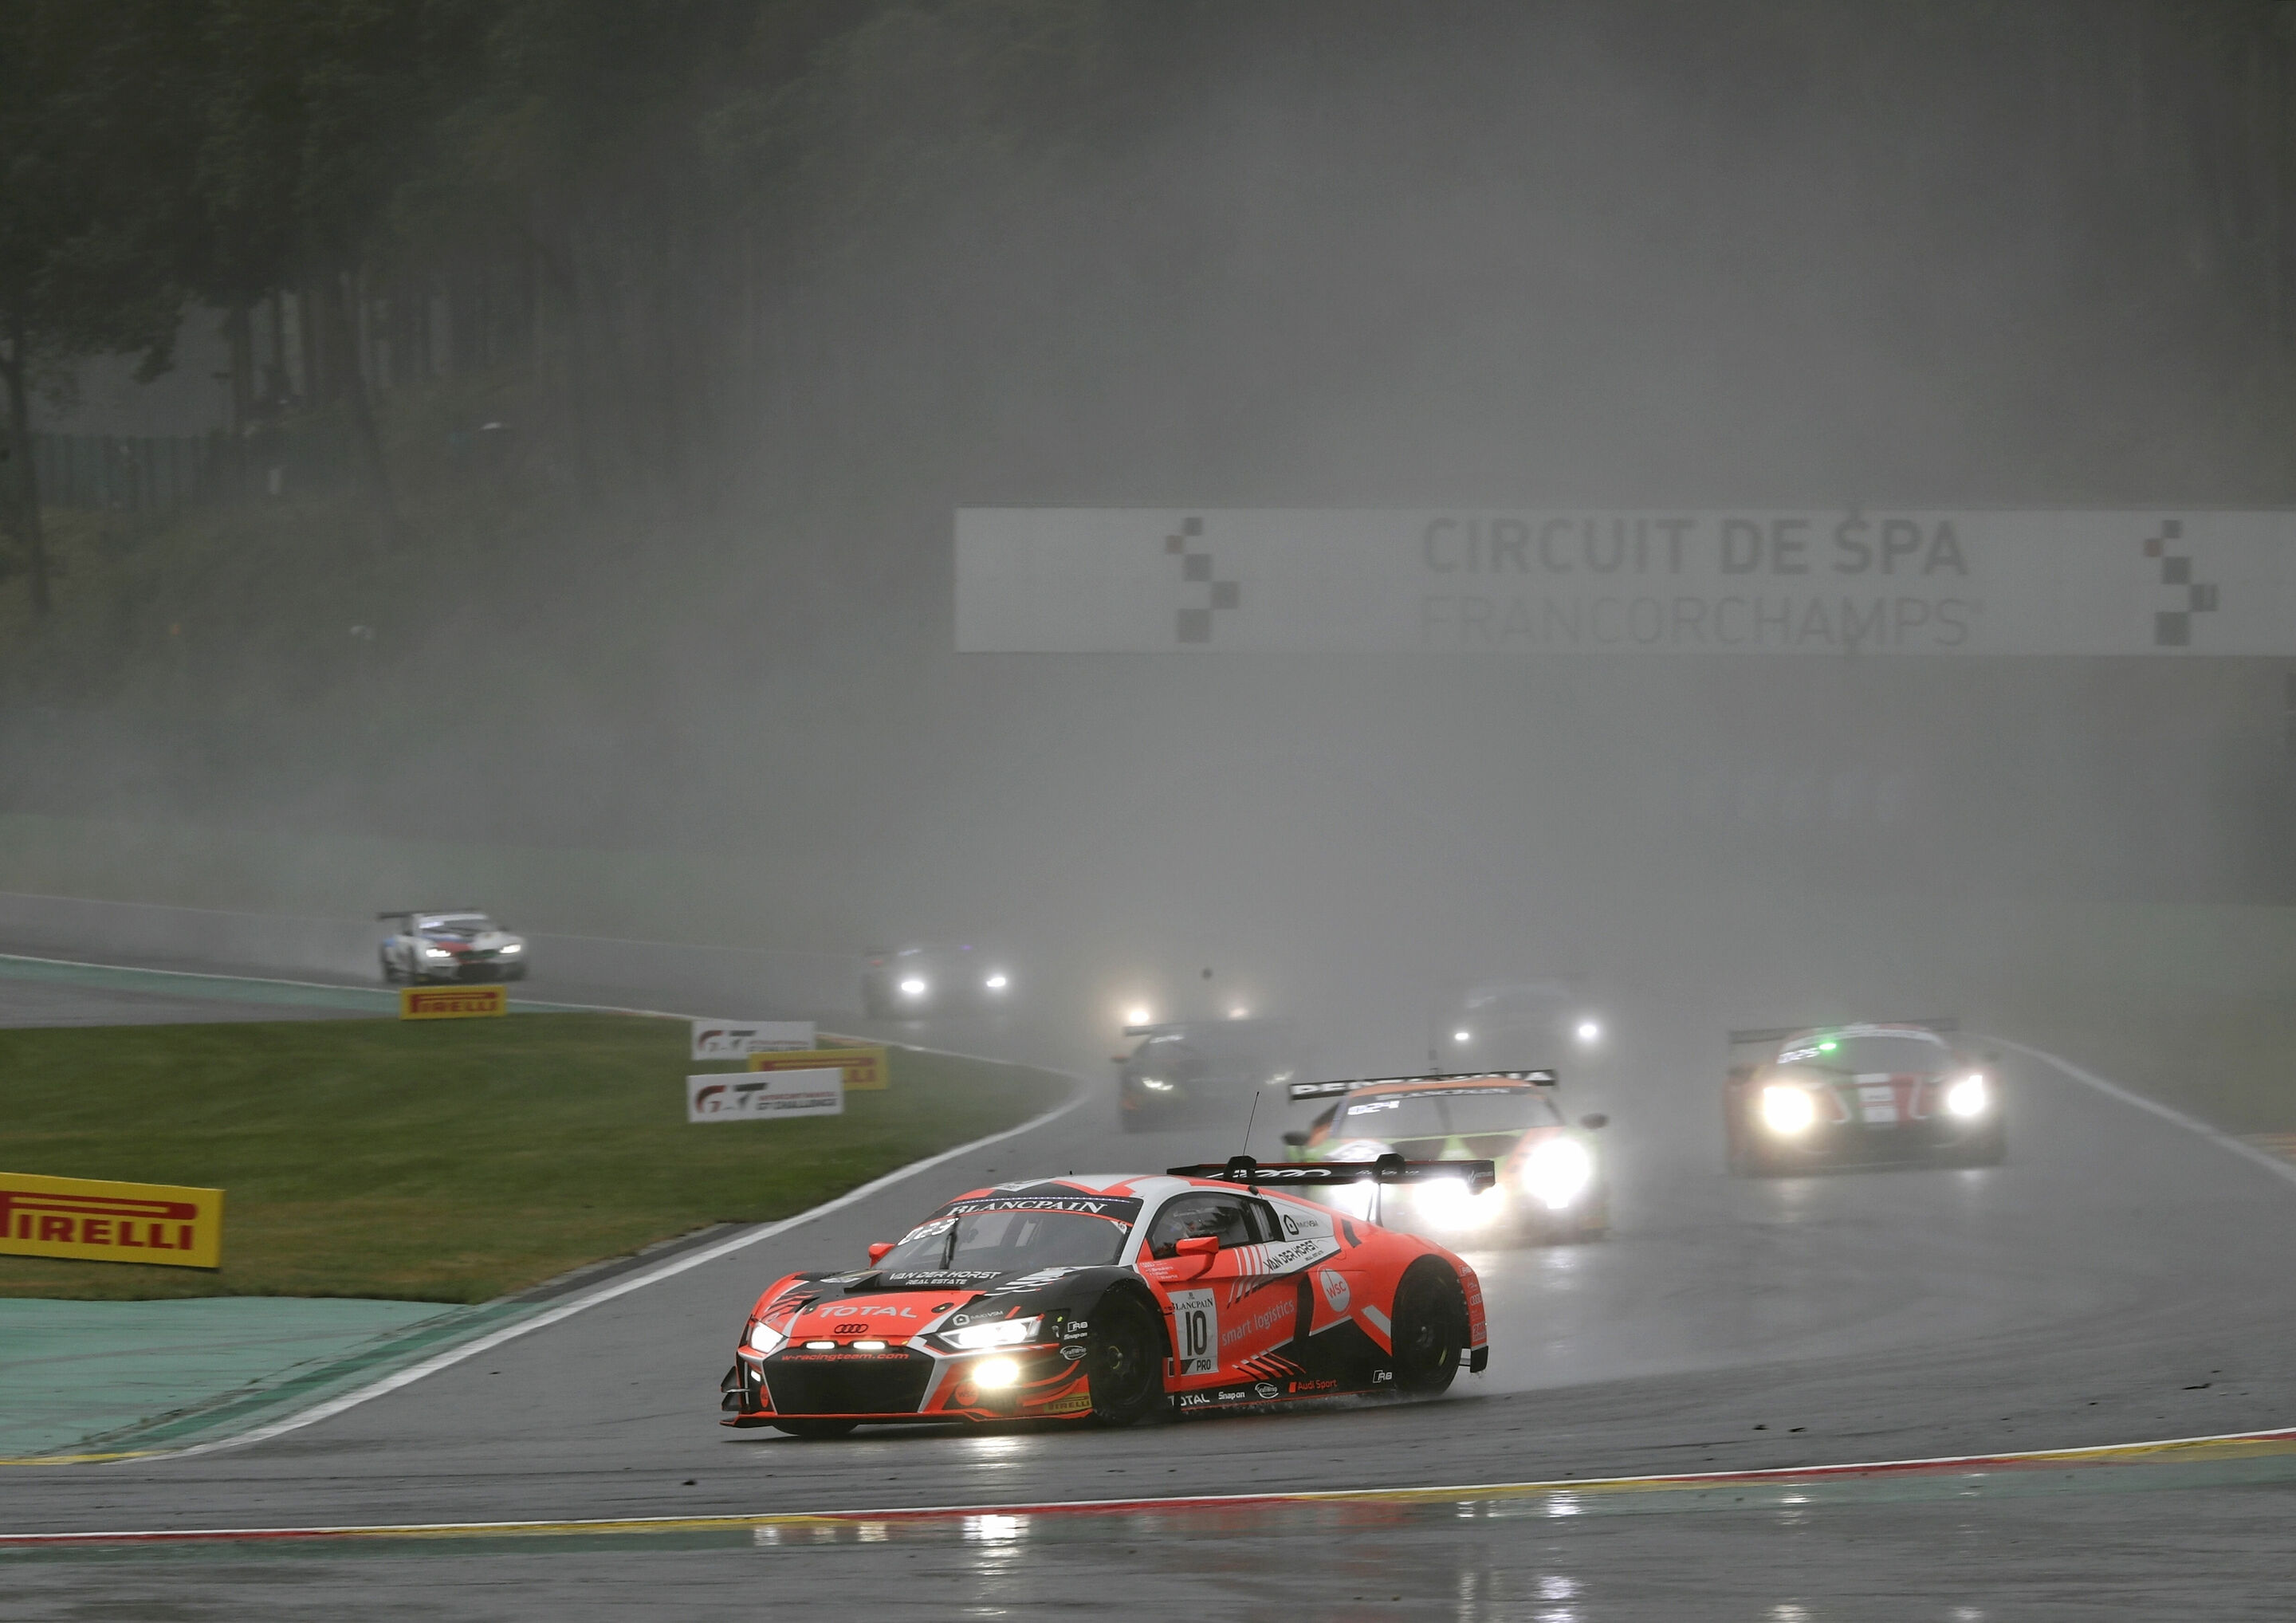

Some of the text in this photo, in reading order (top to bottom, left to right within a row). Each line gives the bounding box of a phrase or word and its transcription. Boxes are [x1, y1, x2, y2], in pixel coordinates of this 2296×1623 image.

[1423, 517, 1968, 576] CIRCUIT DE SPA
[1423, 595, 1969, 647] FRANCORCHAMPS
[410, 992, 498, 1013] PIRELLI
[946, 1201, 1108, 1216] BLANCPAIN
[0, 1190, 197, 1250] PIRELLI
[1263, 1256, 1283, 1271] VAN
[1278, 1249, 1297, 1263] DER
[1291, 1240, 1319, 1257] HORST
[890, 1271, 916, 1280] VAN
[946, 1271, 1001, 1279] HORST
[1327, 1283, 1347, 1299] WSC
[820, 1305, 918, 1318] TOTAL
[1171, 1298, 1213, 1311] BLANCPAIN
[1221, 1299, 1295, 1347] smart logistics
[1185, 1310, 1207, 1356] 10
[781, 1351, 909, 1362] w-racingteam.com
[1197, 1359, 1211, 1371] PRO
[1377, 1371, 1393, 1381] R8
[1316, 1380, 1338, 1389] Sport
[1218, 1391, 1245, 1401] Snap-on
[1048, 1397, 1090, 1410] PIRELLI
